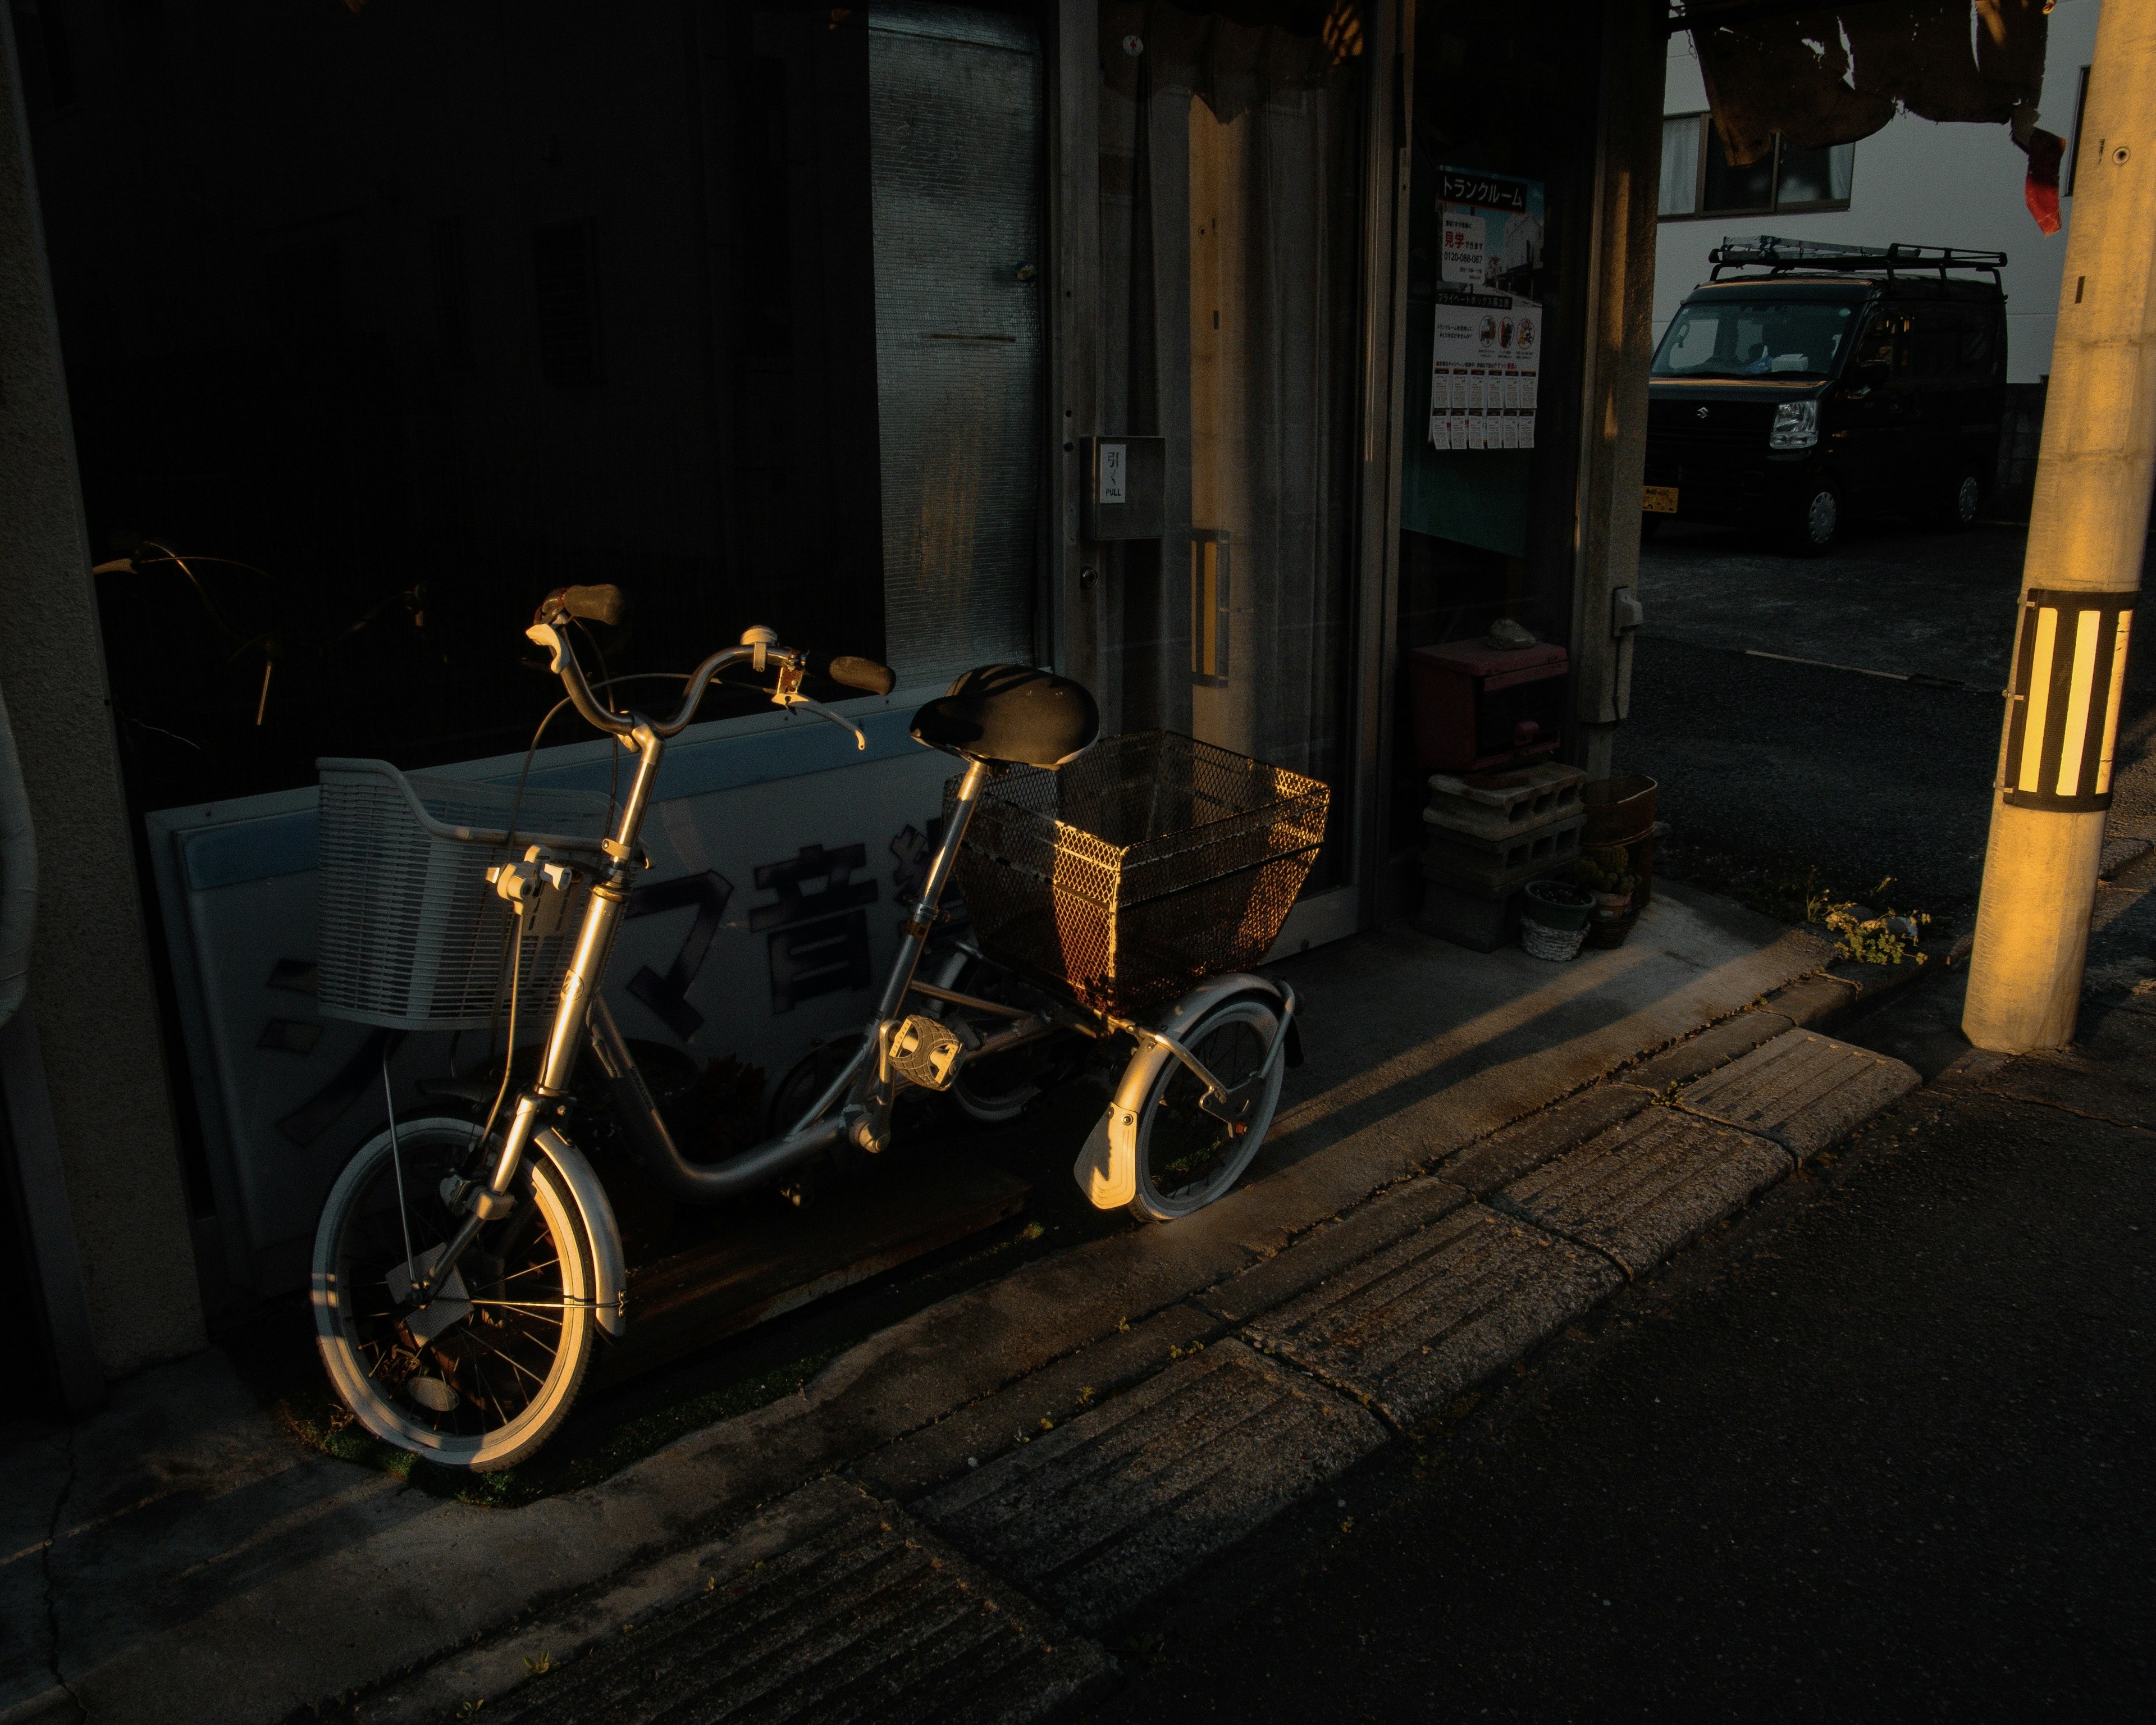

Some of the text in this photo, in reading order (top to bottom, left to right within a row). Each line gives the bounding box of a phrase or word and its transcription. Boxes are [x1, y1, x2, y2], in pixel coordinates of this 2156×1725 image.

[1444, 176, 1523, 207] トランクルーム
[1445, 231, 1483, 250] 見学できます
[1108, 451, 1120, 485] 引く
